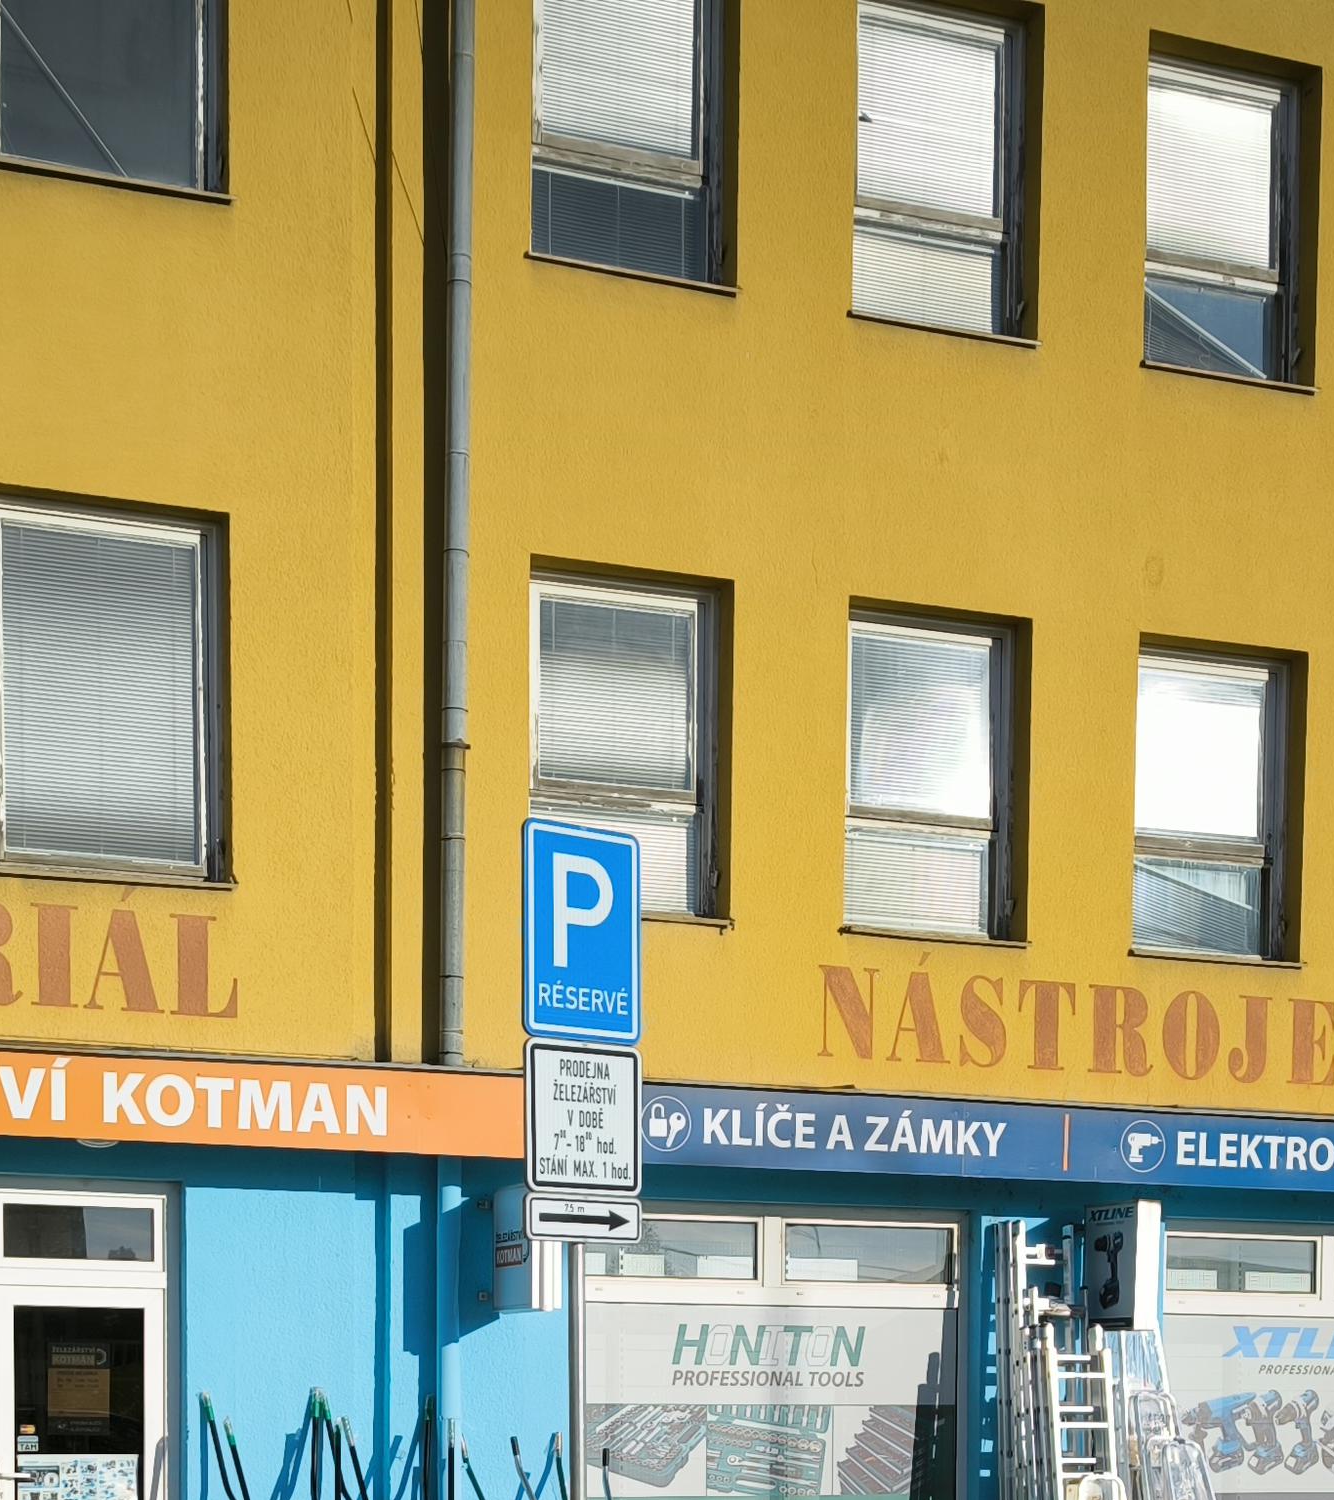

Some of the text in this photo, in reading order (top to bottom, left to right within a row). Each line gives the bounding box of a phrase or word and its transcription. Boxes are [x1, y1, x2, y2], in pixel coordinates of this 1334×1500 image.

[553, 852, 614, 968] P
[538, 981, 629, 1016] RÉSERVÉ
[559, 1058, 610, 1080] PRODEJNA
[102, 1071, 388, 1138] KOTMAN
[553, 1079, 617, 1105] ŽELEZÁŘSTVÍ
[567, 1108, 604, 1129] V DOBĚ
[702, 1102, 1007, 1158] KLÍČE A ZÁMKY
[597, 1137, 617, 1155] hod.
[539, 1154, 631, 1180] STÁNÍ MAX. 1 hod.
[1089, 1206, 1135, 1222] XTLINE
[672, 1370, 865, 1388] PROFESSIONAL TOOLS
